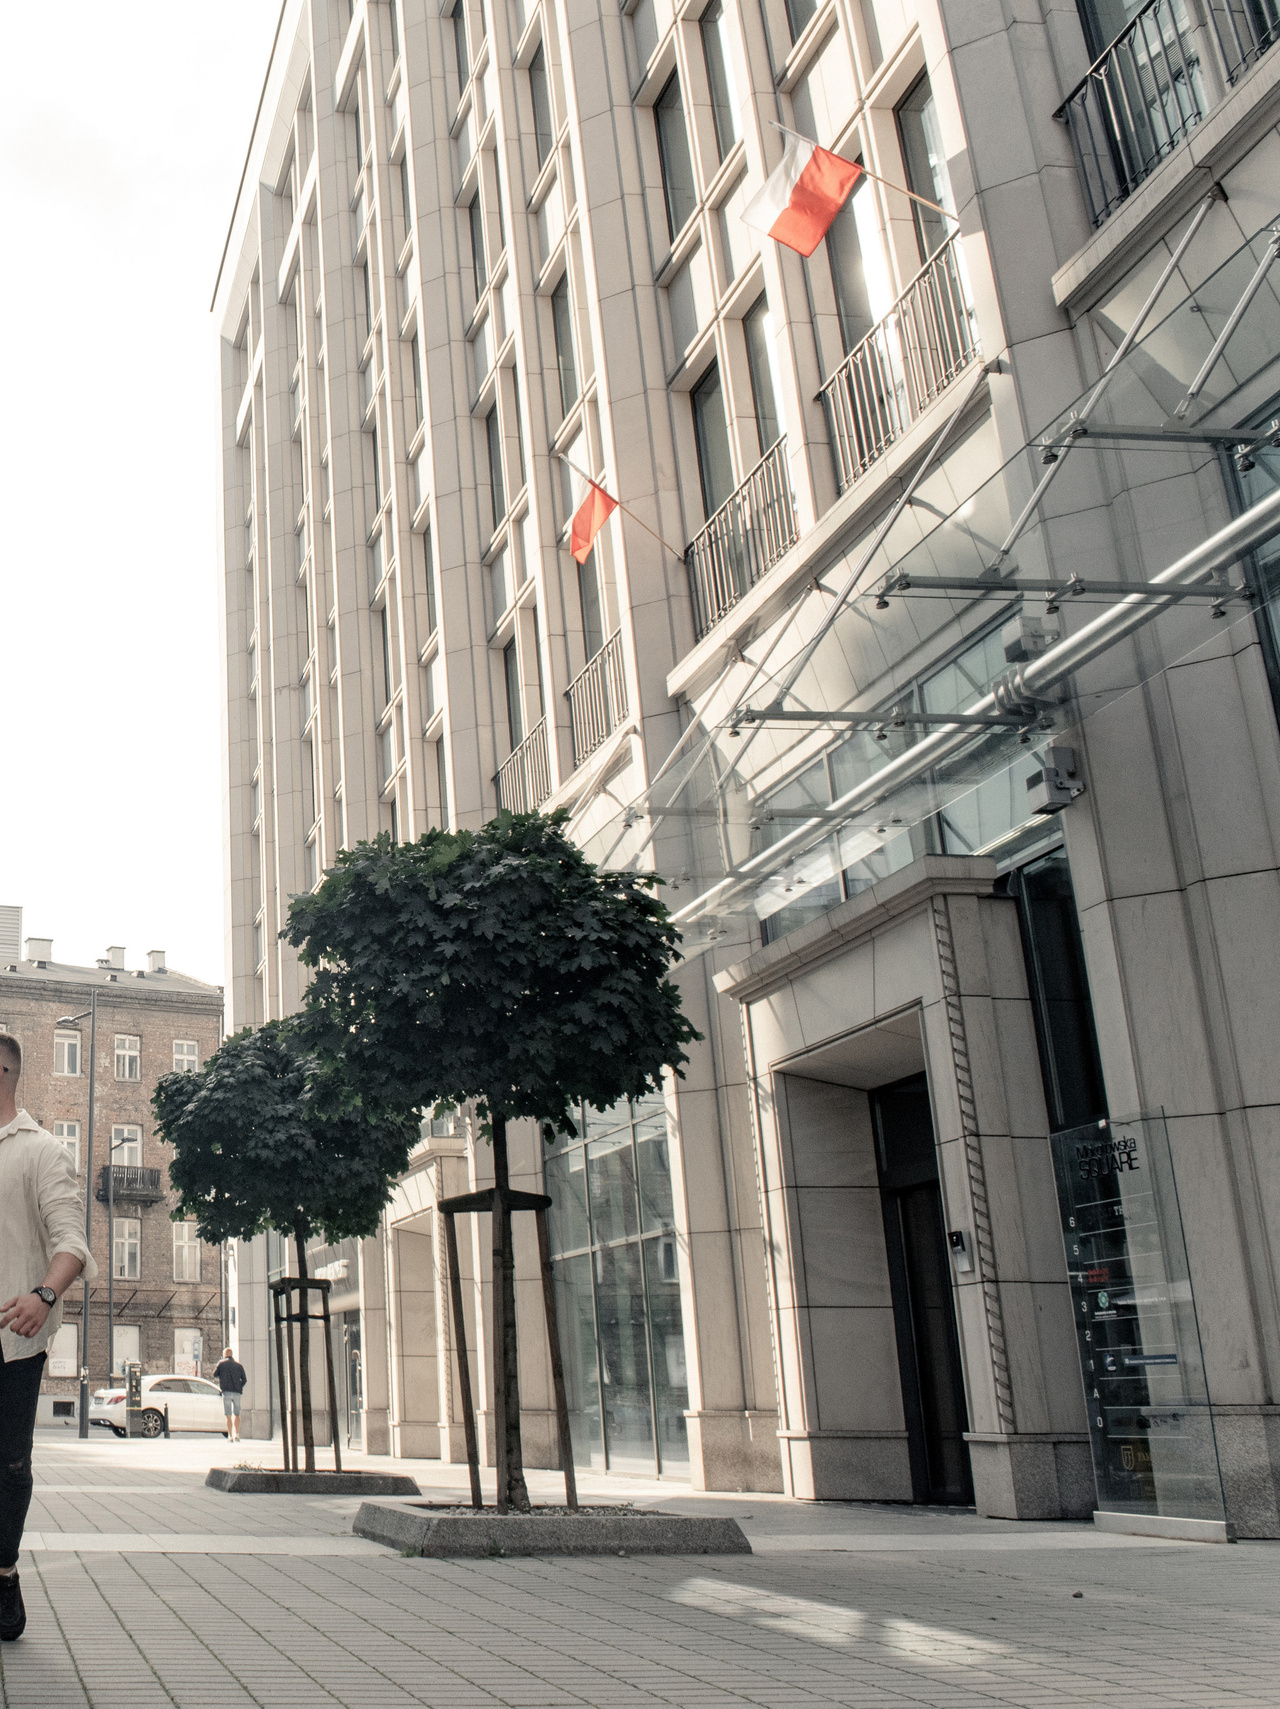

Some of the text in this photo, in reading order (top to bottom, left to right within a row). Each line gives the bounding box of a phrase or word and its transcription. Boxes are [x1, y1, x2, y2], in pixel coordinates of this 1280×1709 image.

[1076, 1136, 1136, 1159] Mokotowska
[1079, 1148, 1140, 1180] SQUARE
[1069, 1216, 1076, 1227] 6
[1073, 1244, 1080, 1256] 5
[1077, 1272, 1084, 1283] 4
[1081, 1301, 1088, 1312] 3
[1085, 1330, 1092, 1341] 2
[1089, 1359, 1095, 1370] 1
[1093, 1388, 1100, 1399] A
